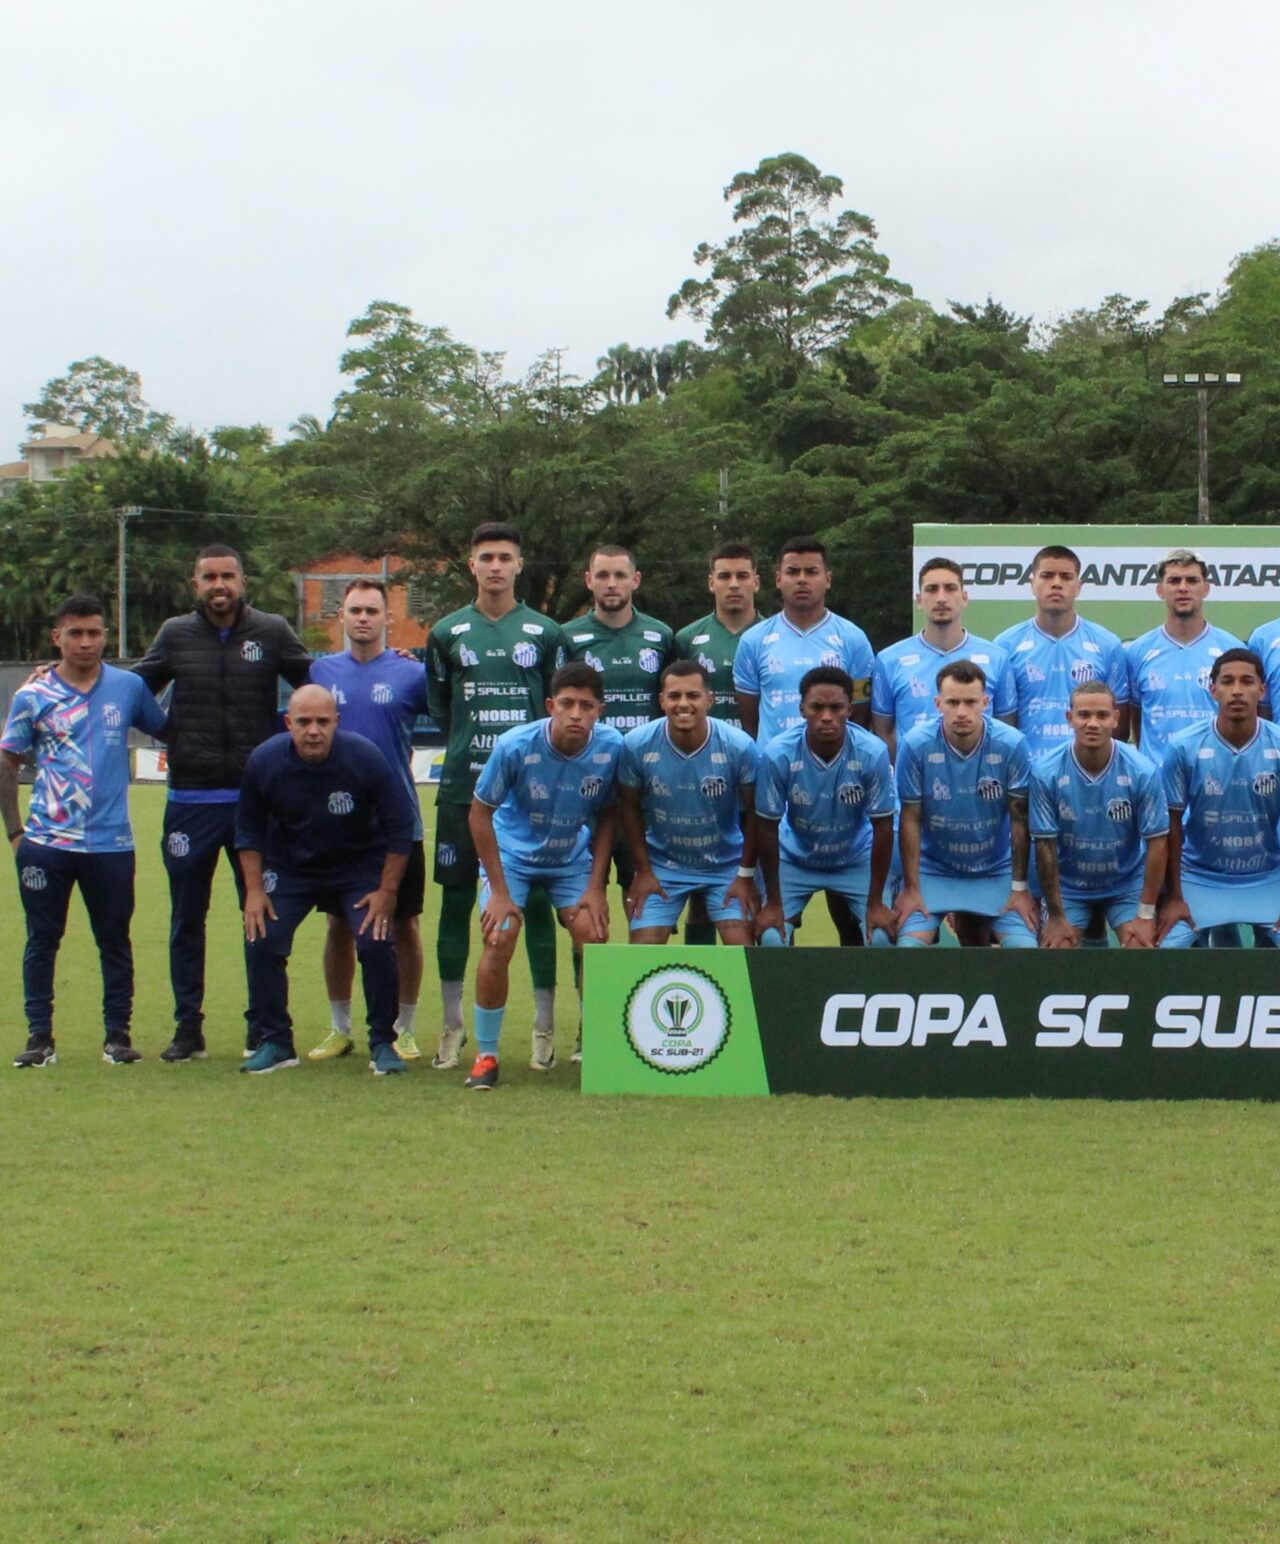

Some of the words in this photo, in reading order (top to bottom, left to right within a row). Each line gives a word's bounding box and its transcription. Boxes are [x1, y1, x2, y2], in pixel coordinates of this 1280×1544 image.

[1078, 563, 1162, 587] ANTA
[478, 709, 527, 722] NOBRE
[820, 993, 1008, 1048] COPA
[1034, 994, 1131, 1048] SC
[662, 1039, 694, 1048] COPA
[650, 1047, 664, 1056] SC
[666, 1047, 705, 1057] SUB-21
